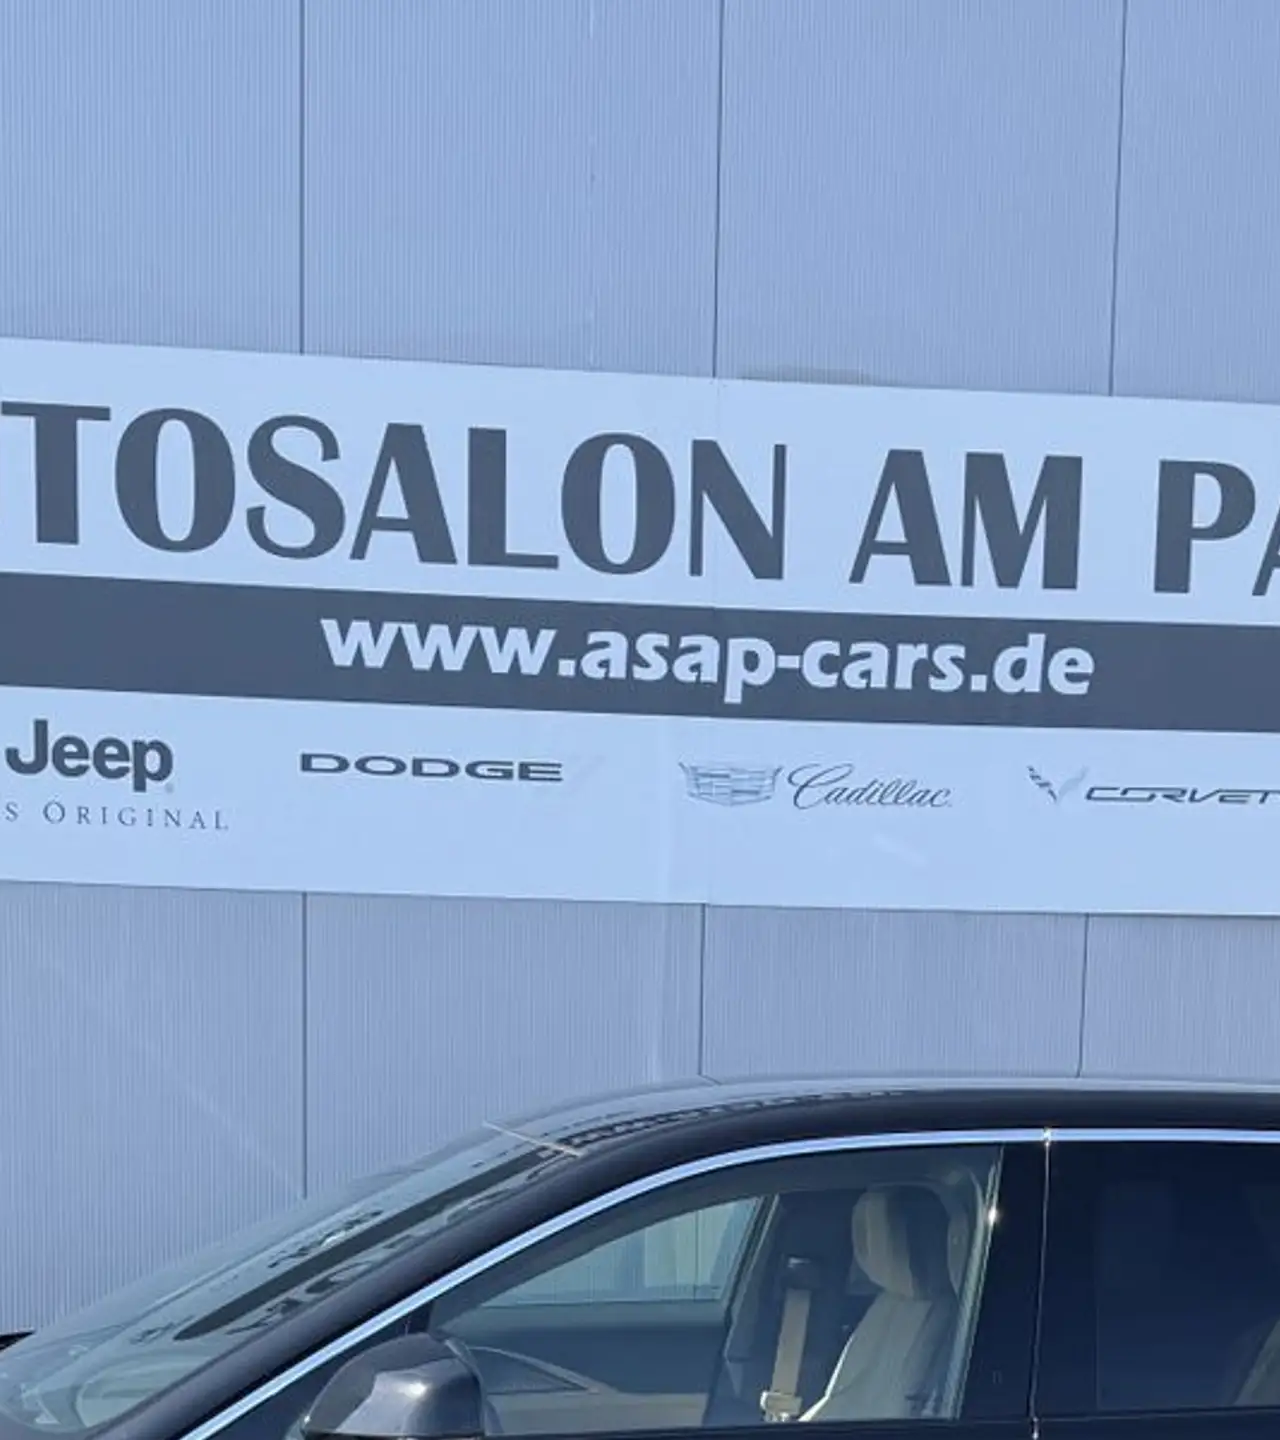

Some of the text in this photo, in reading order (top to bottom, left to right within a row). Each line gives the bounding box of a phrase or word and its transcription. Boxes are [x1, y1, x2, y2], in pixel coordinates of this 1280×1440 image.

[849, 449, 1083, 590] AM
[320, 618, 1094, 704] www.asap-cars.de
[5, 718, 173, 793] Jeep
[300, 753, 564, 782] DODGE
[43, 799, 229, 830] ORIGINAL
[787, 763, 951, 809] Cadillac
